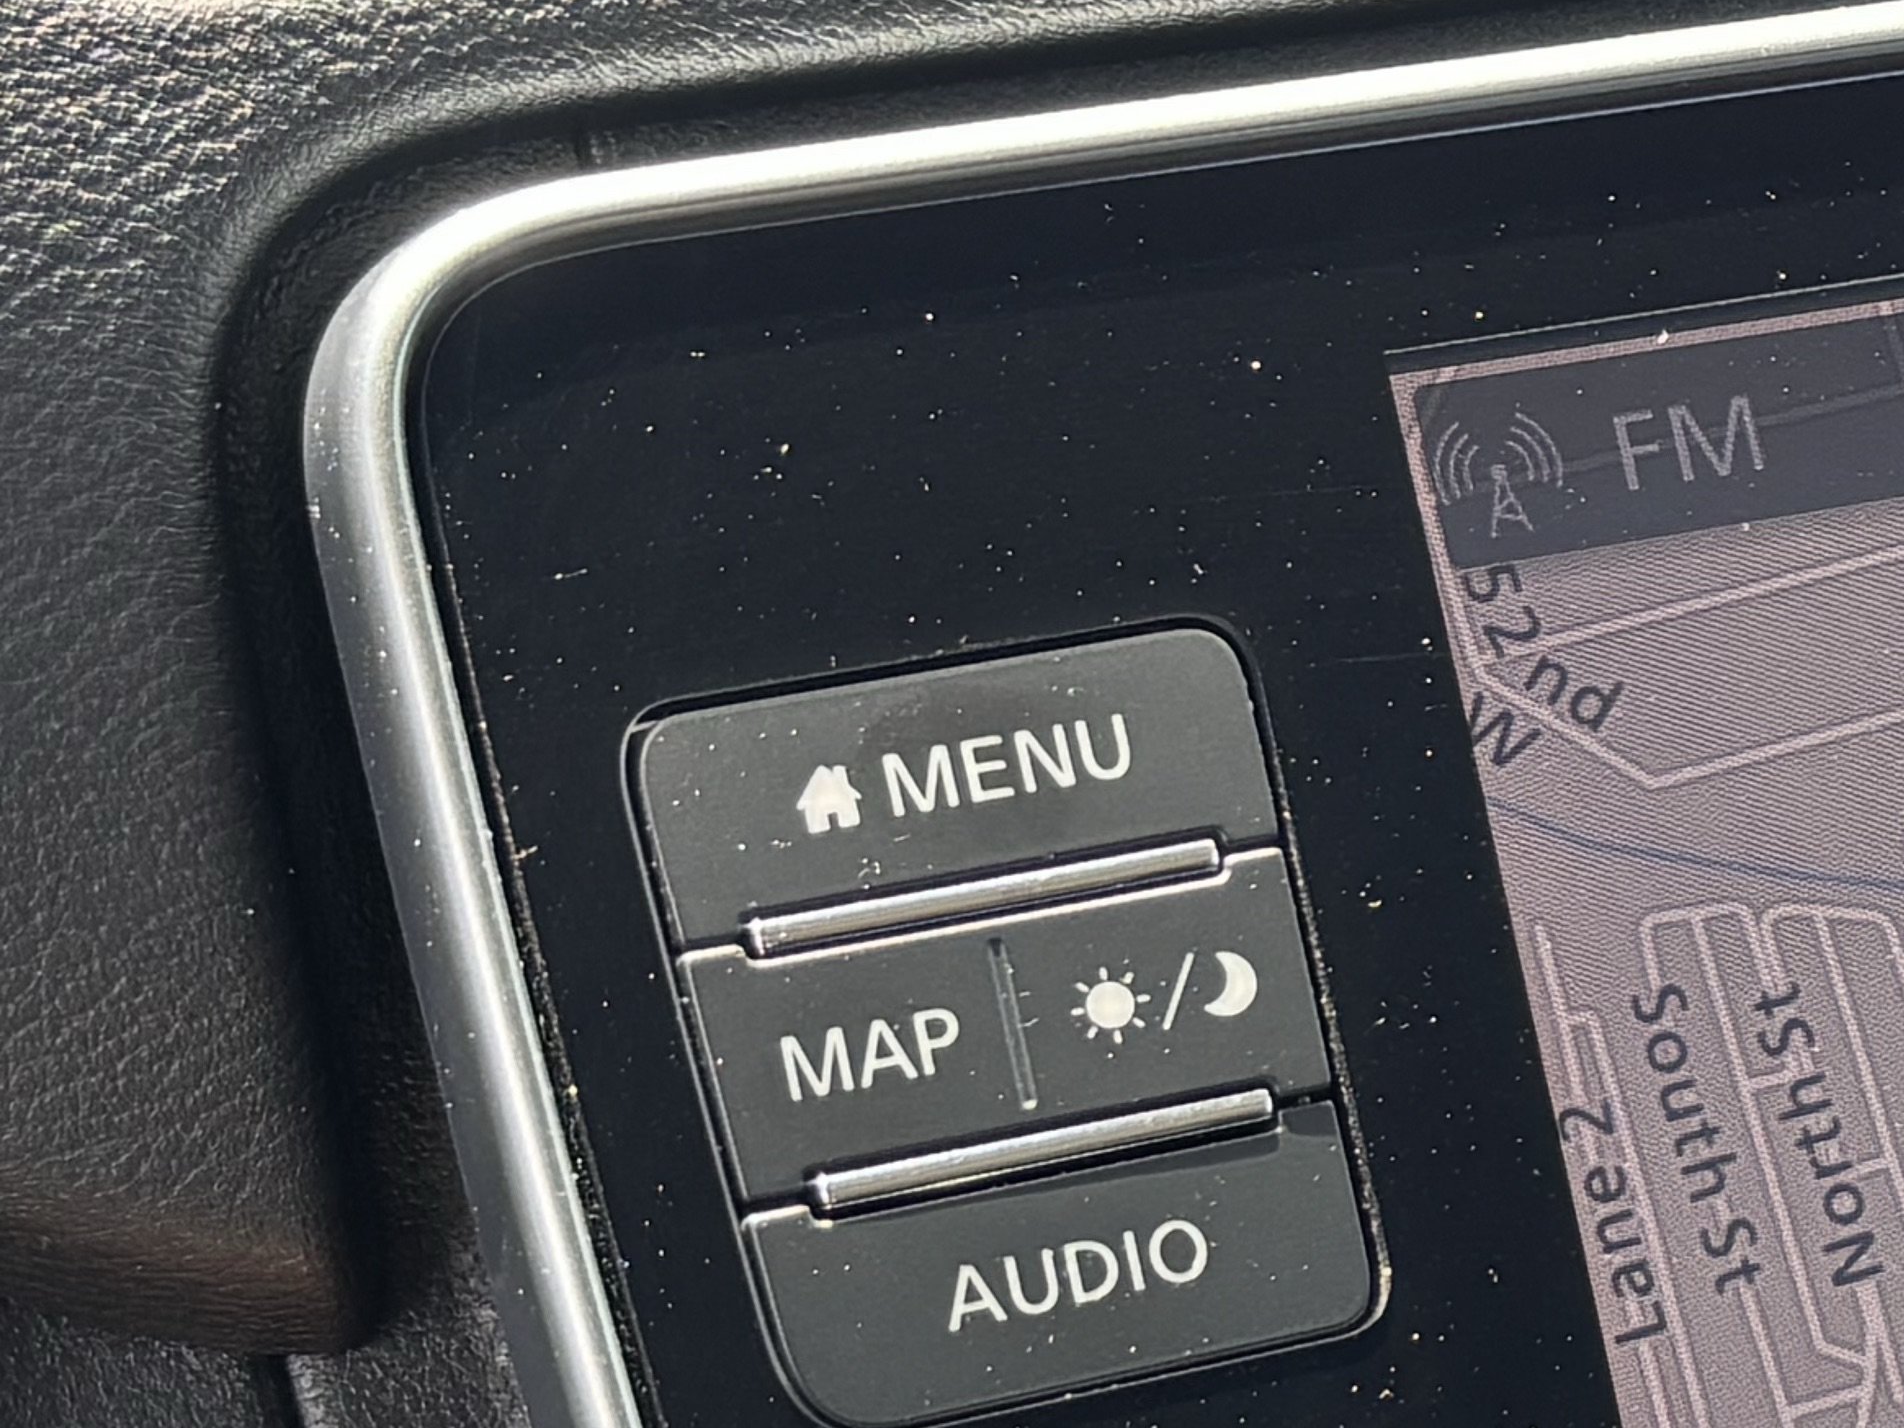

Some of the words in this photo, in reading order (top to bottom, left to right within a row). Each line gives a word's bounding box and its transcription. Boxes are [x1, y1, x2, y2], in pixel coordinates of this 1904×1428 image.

[1612, 395, 1765, 491] FM
[1462, 563, 1624, 732] 52nd
[881, 713, 1133, 818] MENU
[779, 1007, 961, 1102] MAP
[1753, 982, 1816, 1058] St
[1559, 1099, 1615, 1142] 2
[1632, 982, 1737, 1204] South
[1701, 1217, 1761, 1295] St
[1779, 1071, 1884, 1288] North
[948, 1219, 1209, 1333] AUDIO
[1584, 1162, 1668, 1345] Lane
